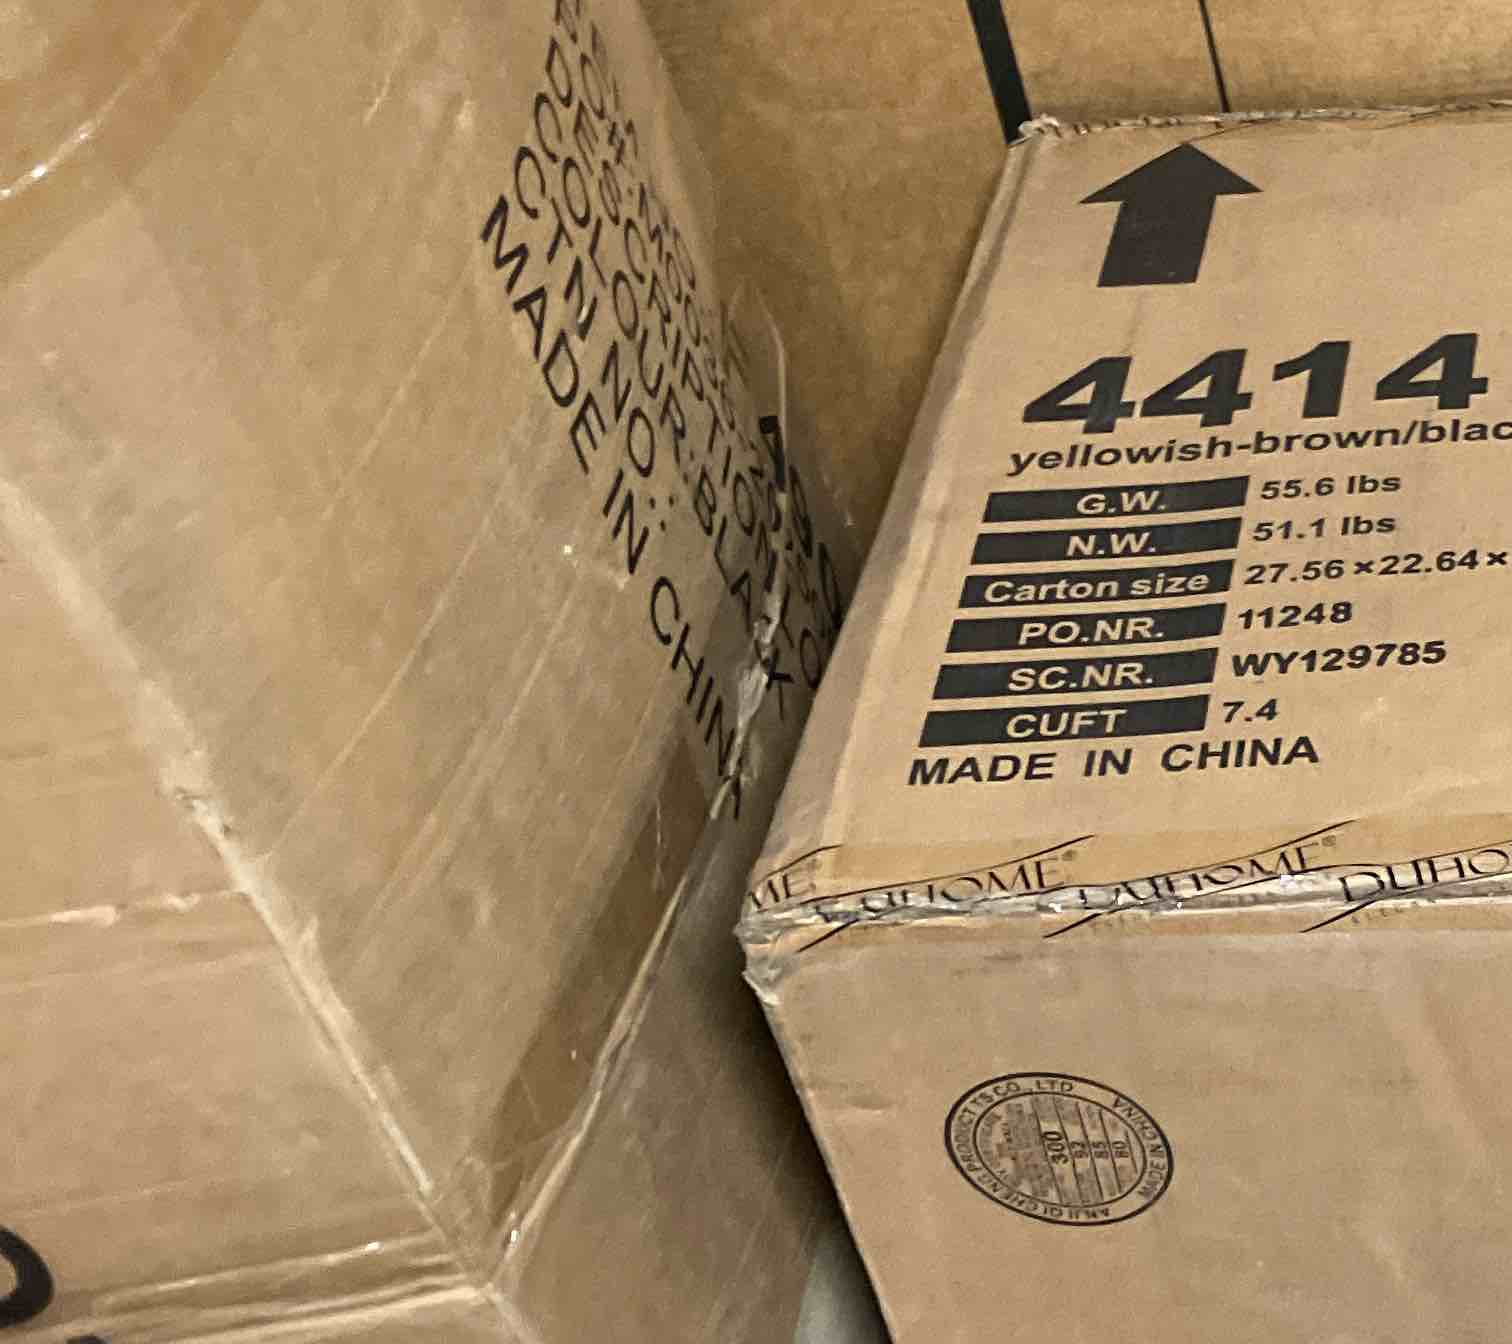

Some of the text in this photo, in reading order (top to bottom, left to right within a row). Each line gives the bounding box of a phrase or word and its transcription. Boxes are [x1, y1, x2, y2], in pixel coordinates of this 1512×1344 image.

[513, 142, 597, 342] CTN
[480, 195, 607, 473] MADE
[600, 467, 652, 576] IN
[1021, 331, 1489, 435] 4414
[1076, 473, 1402, 516] G.W. 55.6 lbs
[1065, 514, 1397, 558] N.W. 51.1 lbs
[983, 576, 1119, 604] Carton
[1130, 571, 1210, 597] size
[1016, 600, 1354, 646] PO.NR. 11248
[1007, 639, 1448, 692] SC.NR. WY129785
[1005, 698, 1280, 739] CUFT 7.4
[906, 734, 1321, 786] MADE IN CHINA
